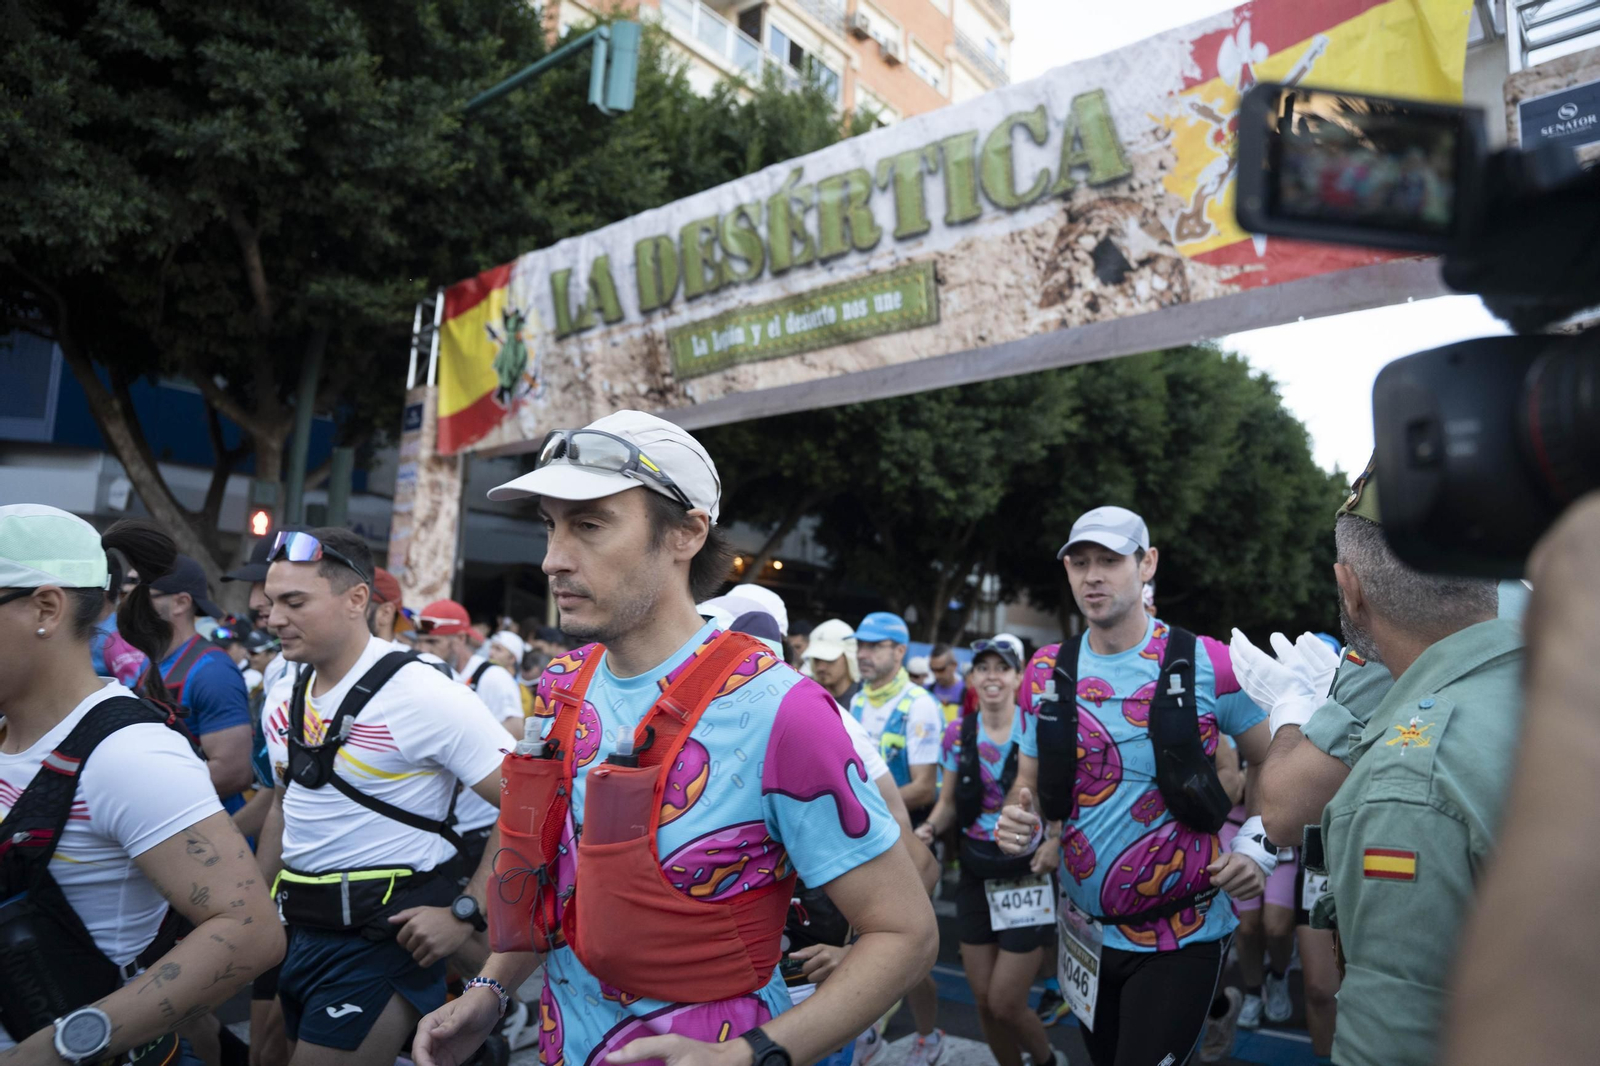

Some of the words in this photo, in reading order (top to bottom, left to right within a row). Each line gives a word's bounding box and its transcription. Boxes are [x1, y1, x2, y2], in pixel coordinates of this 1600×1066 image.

[1541, 114, 1598, 136] SENATOR
[549, 253, 625, 341] LA
[635, 87, 1133, 316] DESÉRTICA
[750, 324, 761, 346] y
[767, 315, 781, 339] el
[842, 299, 869, 321] nos
[873, 290, 904, 314] une
[1001, 889, 1044, 911] 4047
